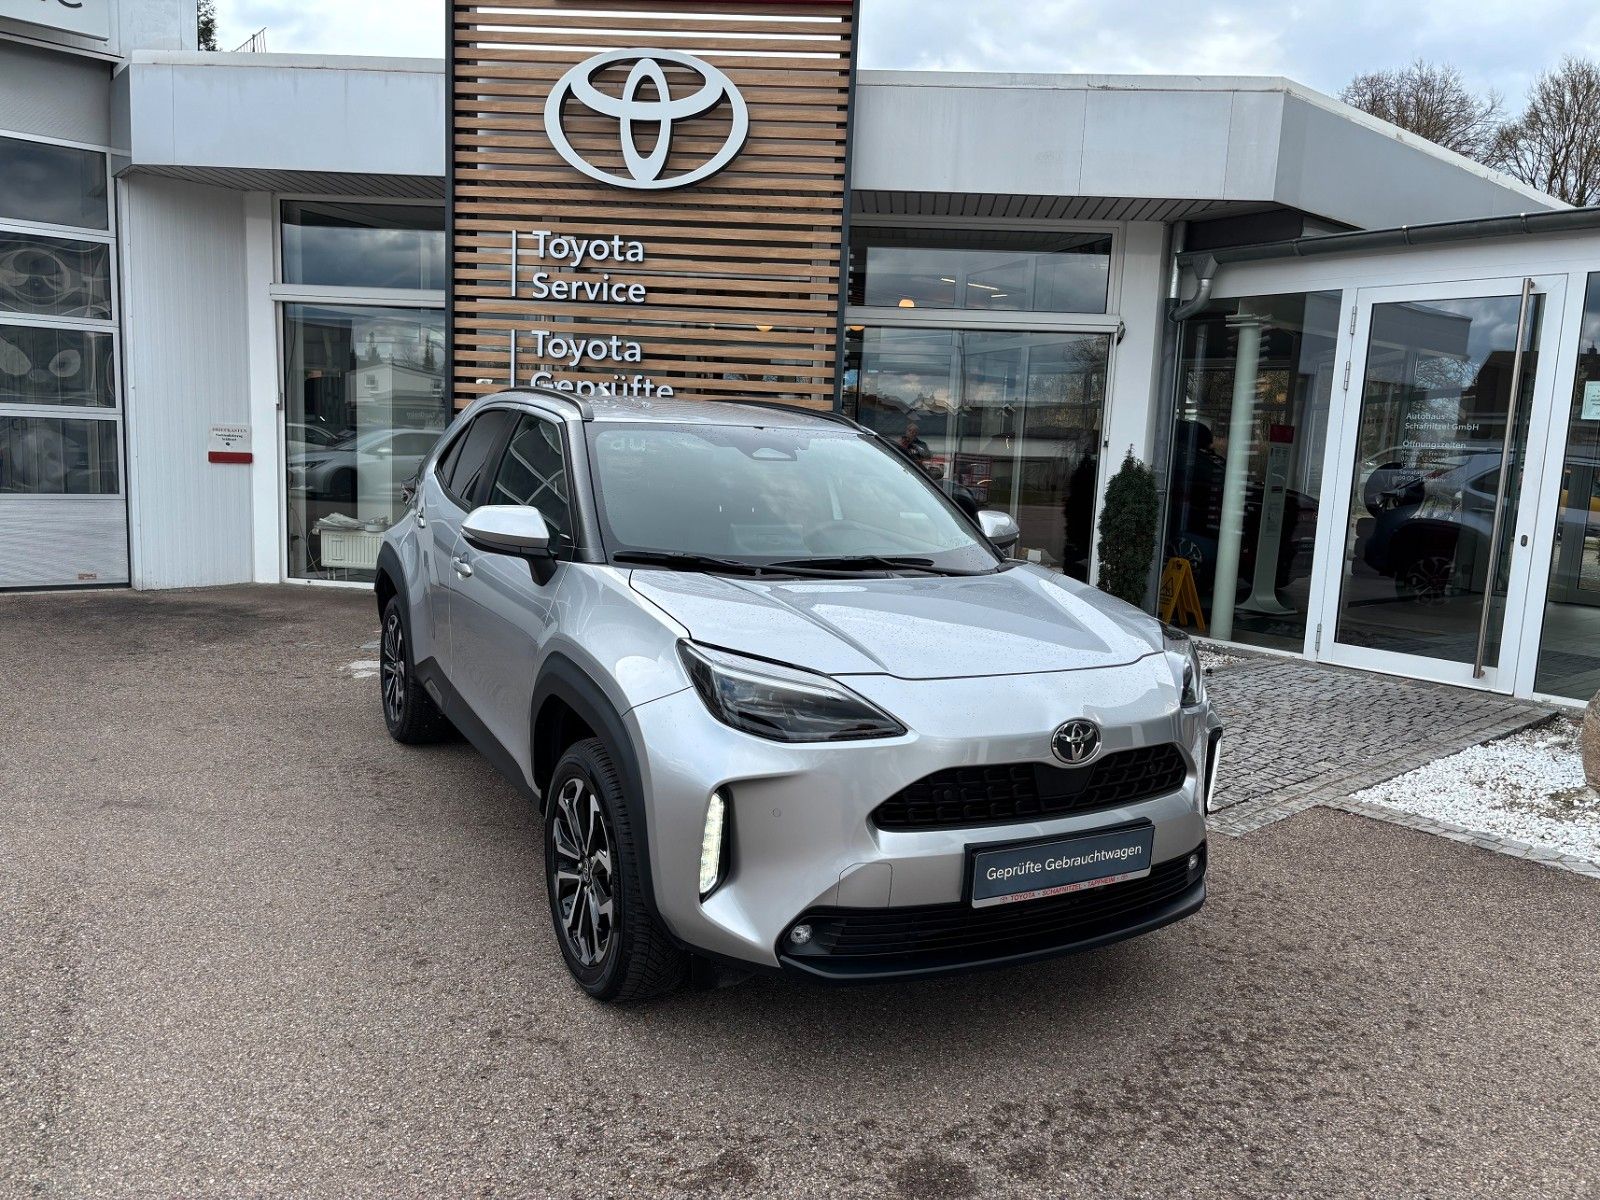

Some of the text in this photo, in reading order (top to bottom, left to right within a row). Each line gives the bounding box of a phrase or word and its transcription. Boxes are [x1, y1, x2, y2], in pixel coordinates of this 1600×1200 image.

[532, 230, 645, 268] Toyota
[532, 271, 646, 303] Service
[531, 329, 643, 367] Toyota
[1405, 412, 1446, 421] Autohaus
[1451, 423, 1480, 431] GmbH
[1402, 440, 1467, 450] Öffnungszeiten
[986, 844, 1142, 881] Geprüfte Gebrauchtwagen
[1010, 891, 1036, 902] TOYOTA
